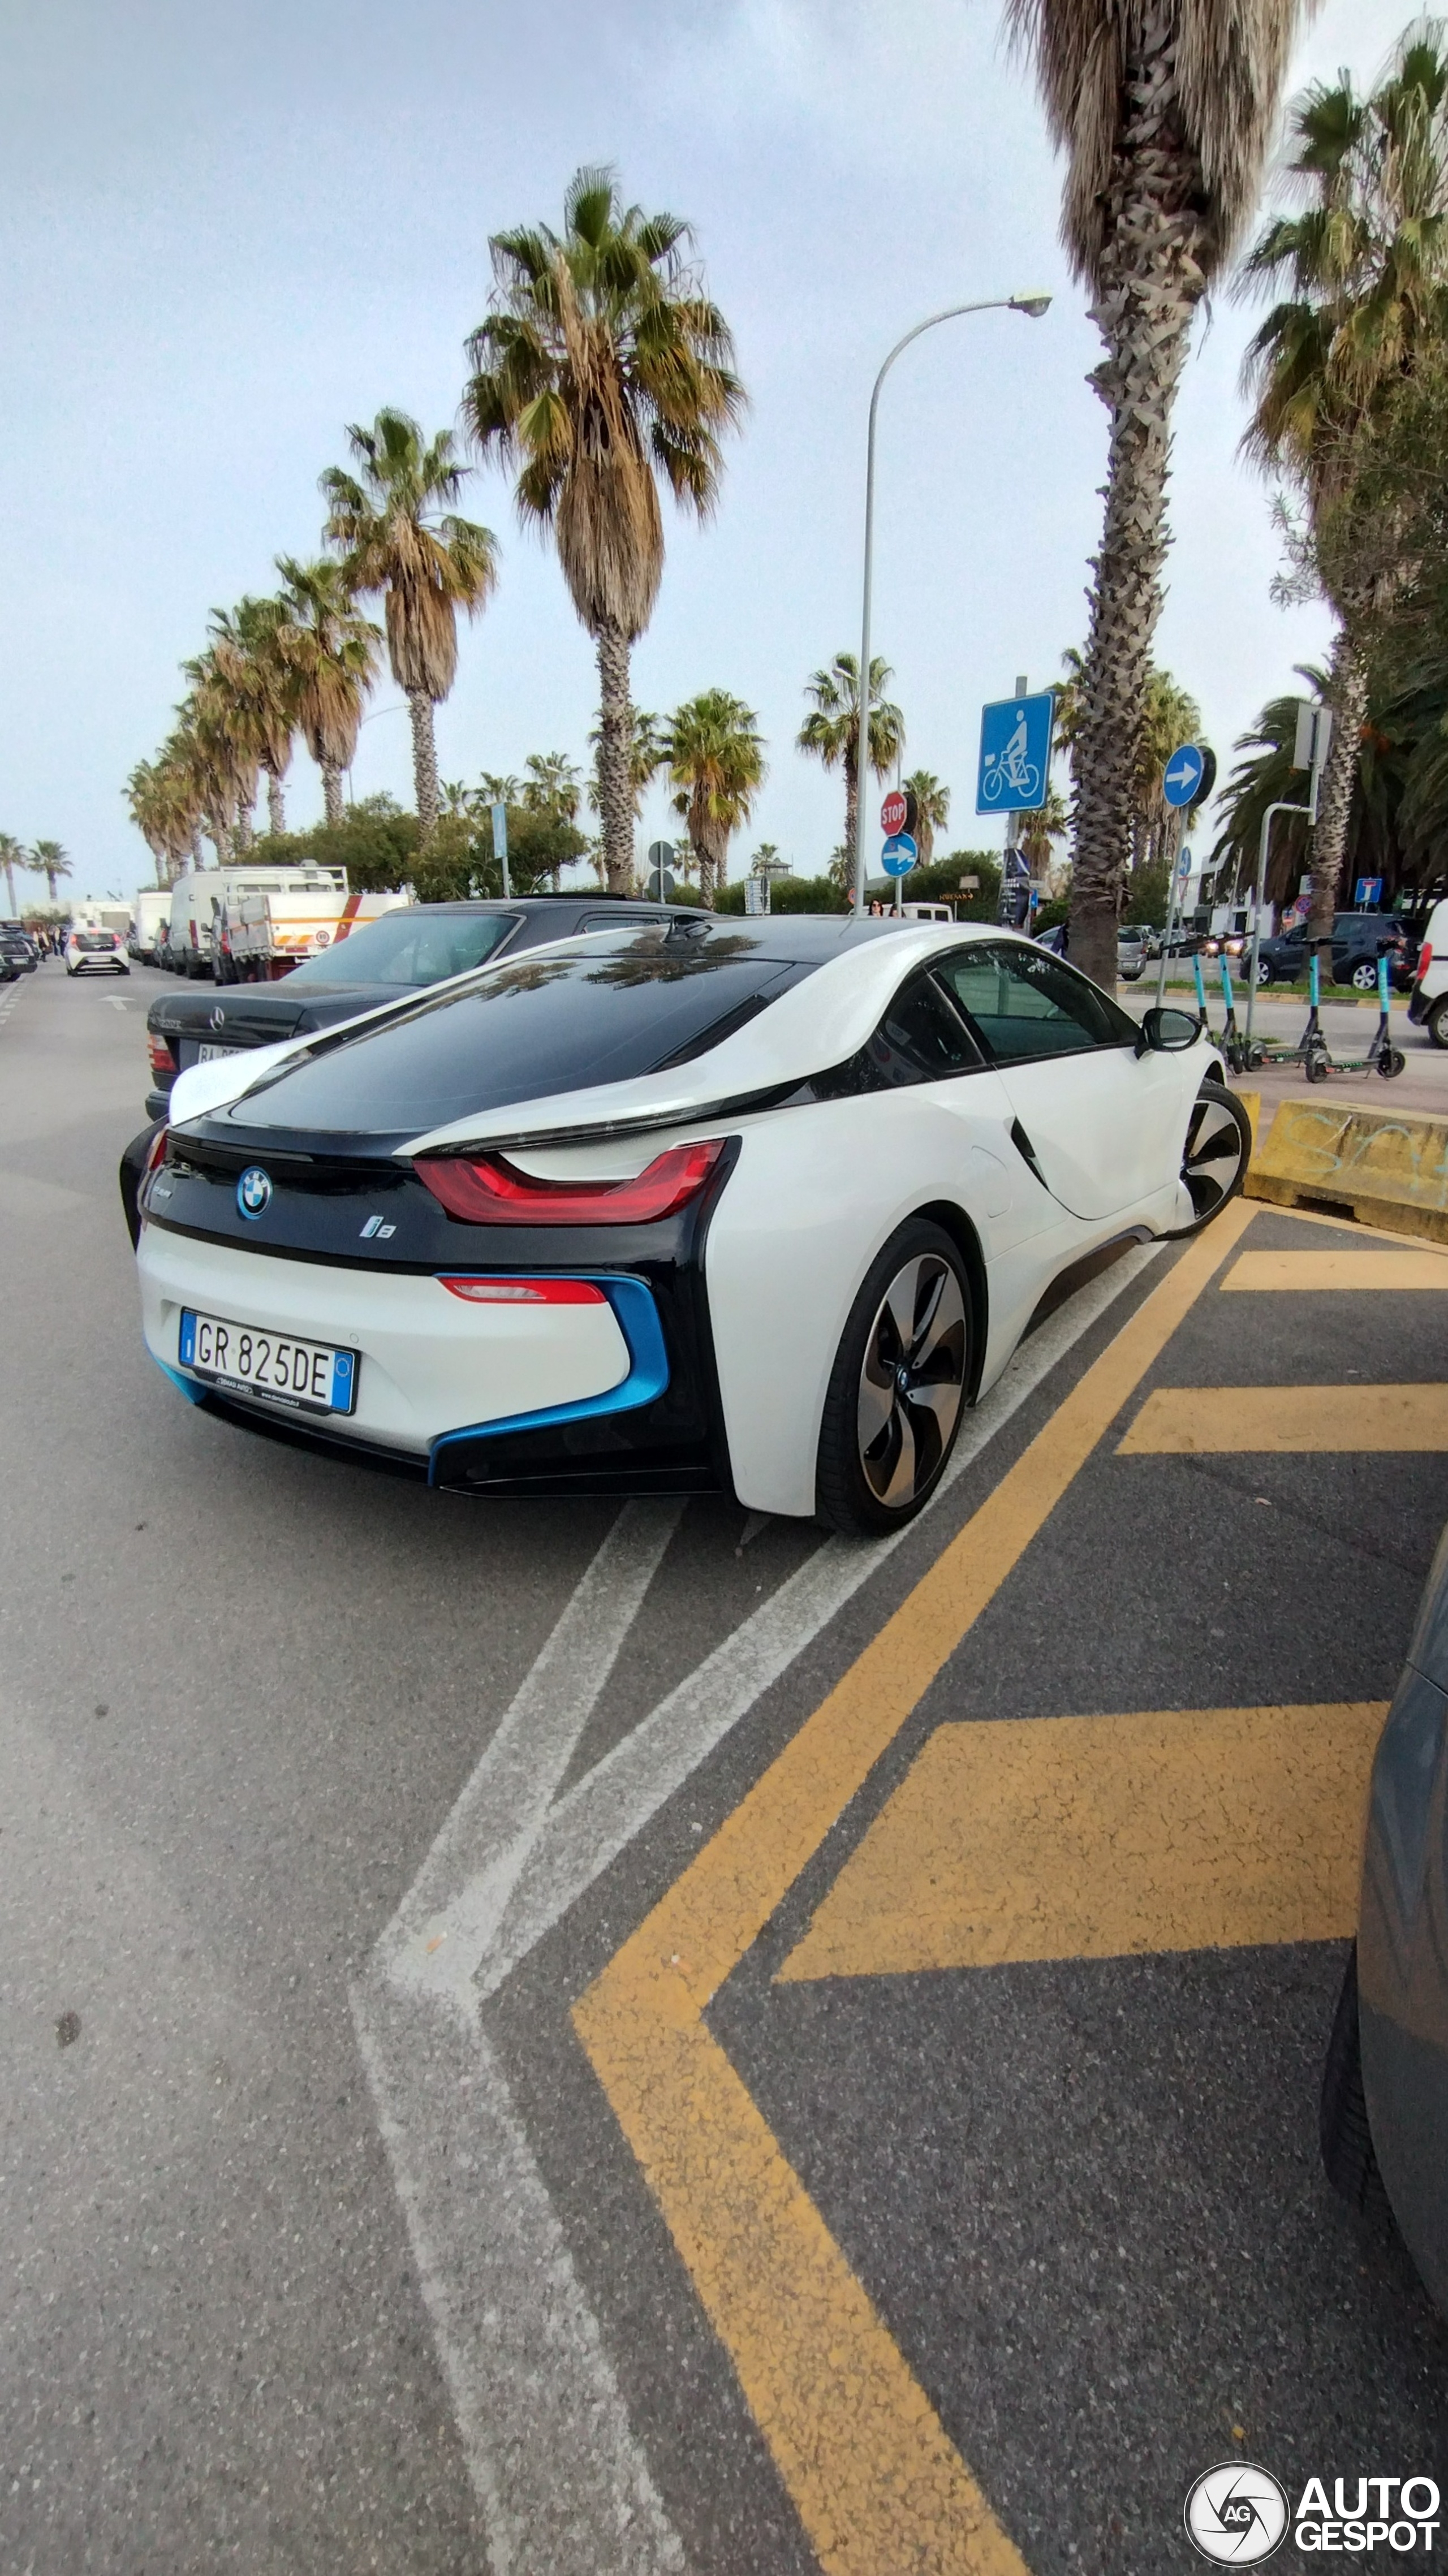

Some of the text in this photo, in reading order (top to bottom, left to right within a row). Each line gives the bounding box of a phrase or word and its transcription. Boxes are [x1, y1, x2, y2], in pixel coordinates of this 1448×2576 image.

[882, 803, 904, 825] STOP
[244, 1171, 268, 1188] BMW
[359, 1215, 397, 1239] i8
[199, 1323, 329, 1399] GR 825DE
